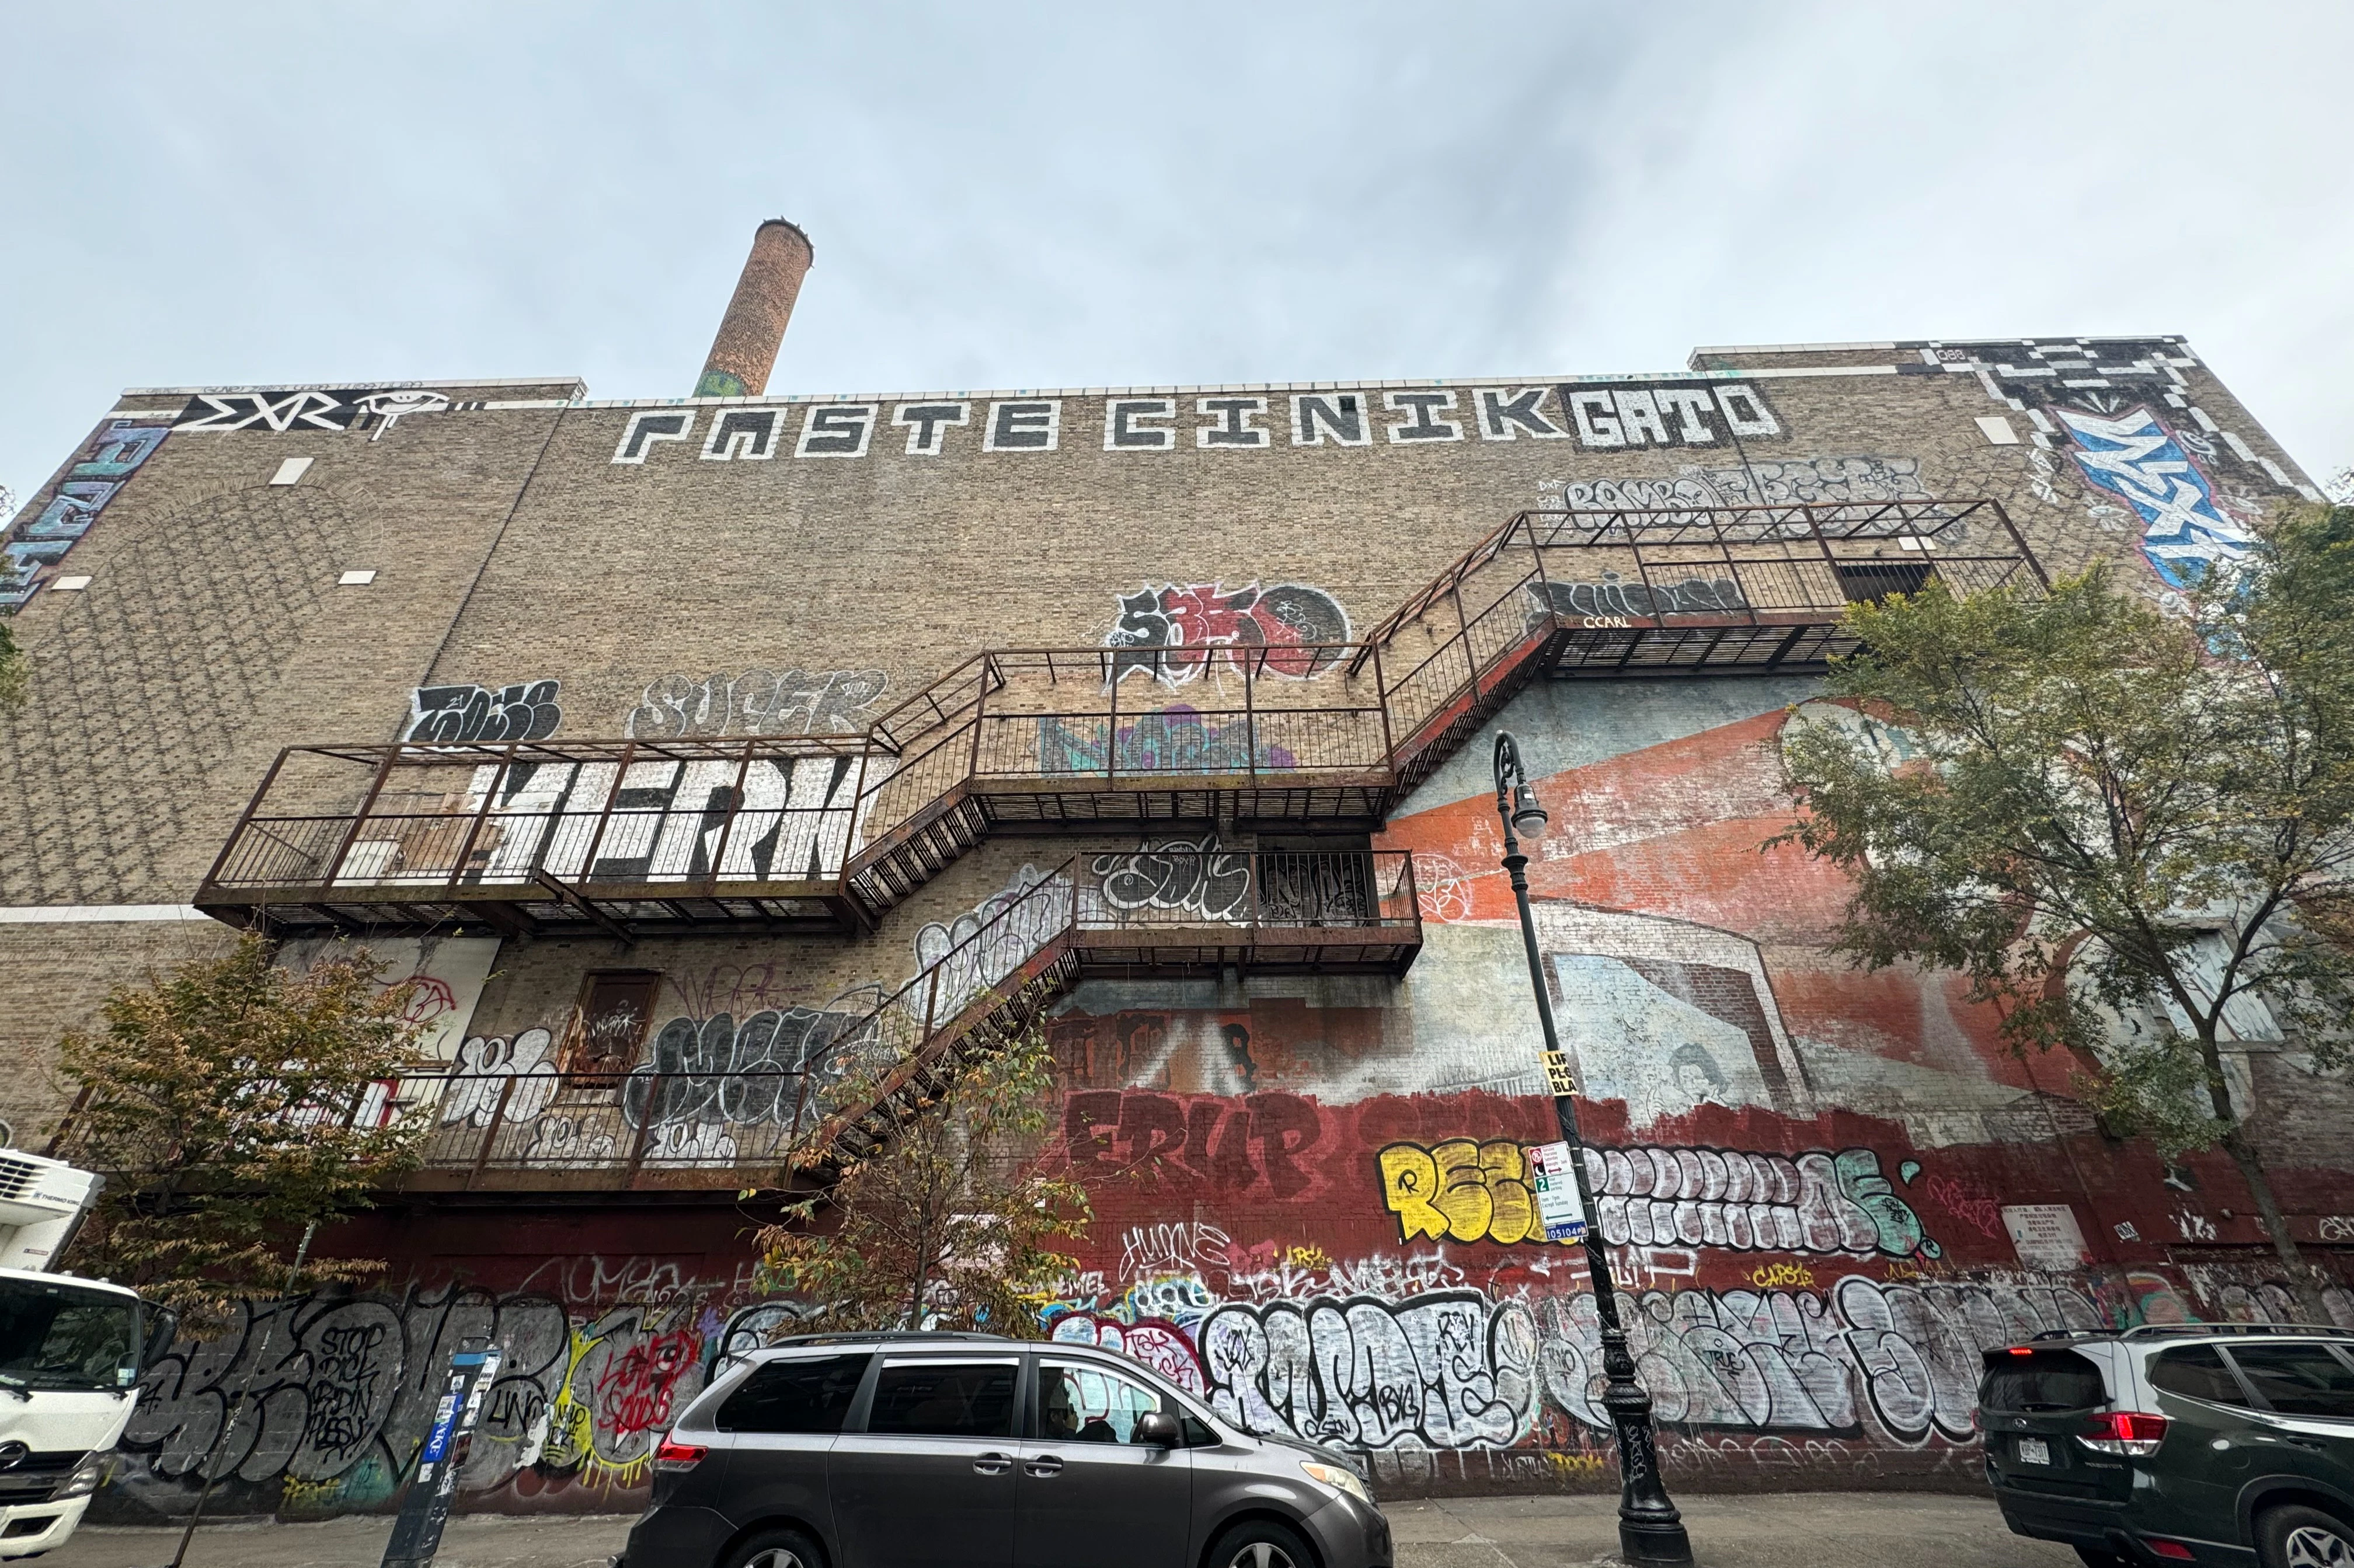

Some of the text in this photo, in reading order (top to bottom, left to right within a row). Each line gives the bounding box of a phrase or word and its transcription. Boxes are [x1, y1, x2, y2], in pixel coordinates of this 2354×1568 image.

[1583, 616, 1632, 629] CCARL
[1538, 1179, 1547, 1191] 2
[42, 1194, 67, 1203] THERMO
[1547, 1228, 1576, 1239] 105104
[322, 1322, 386, 1356] STOP
